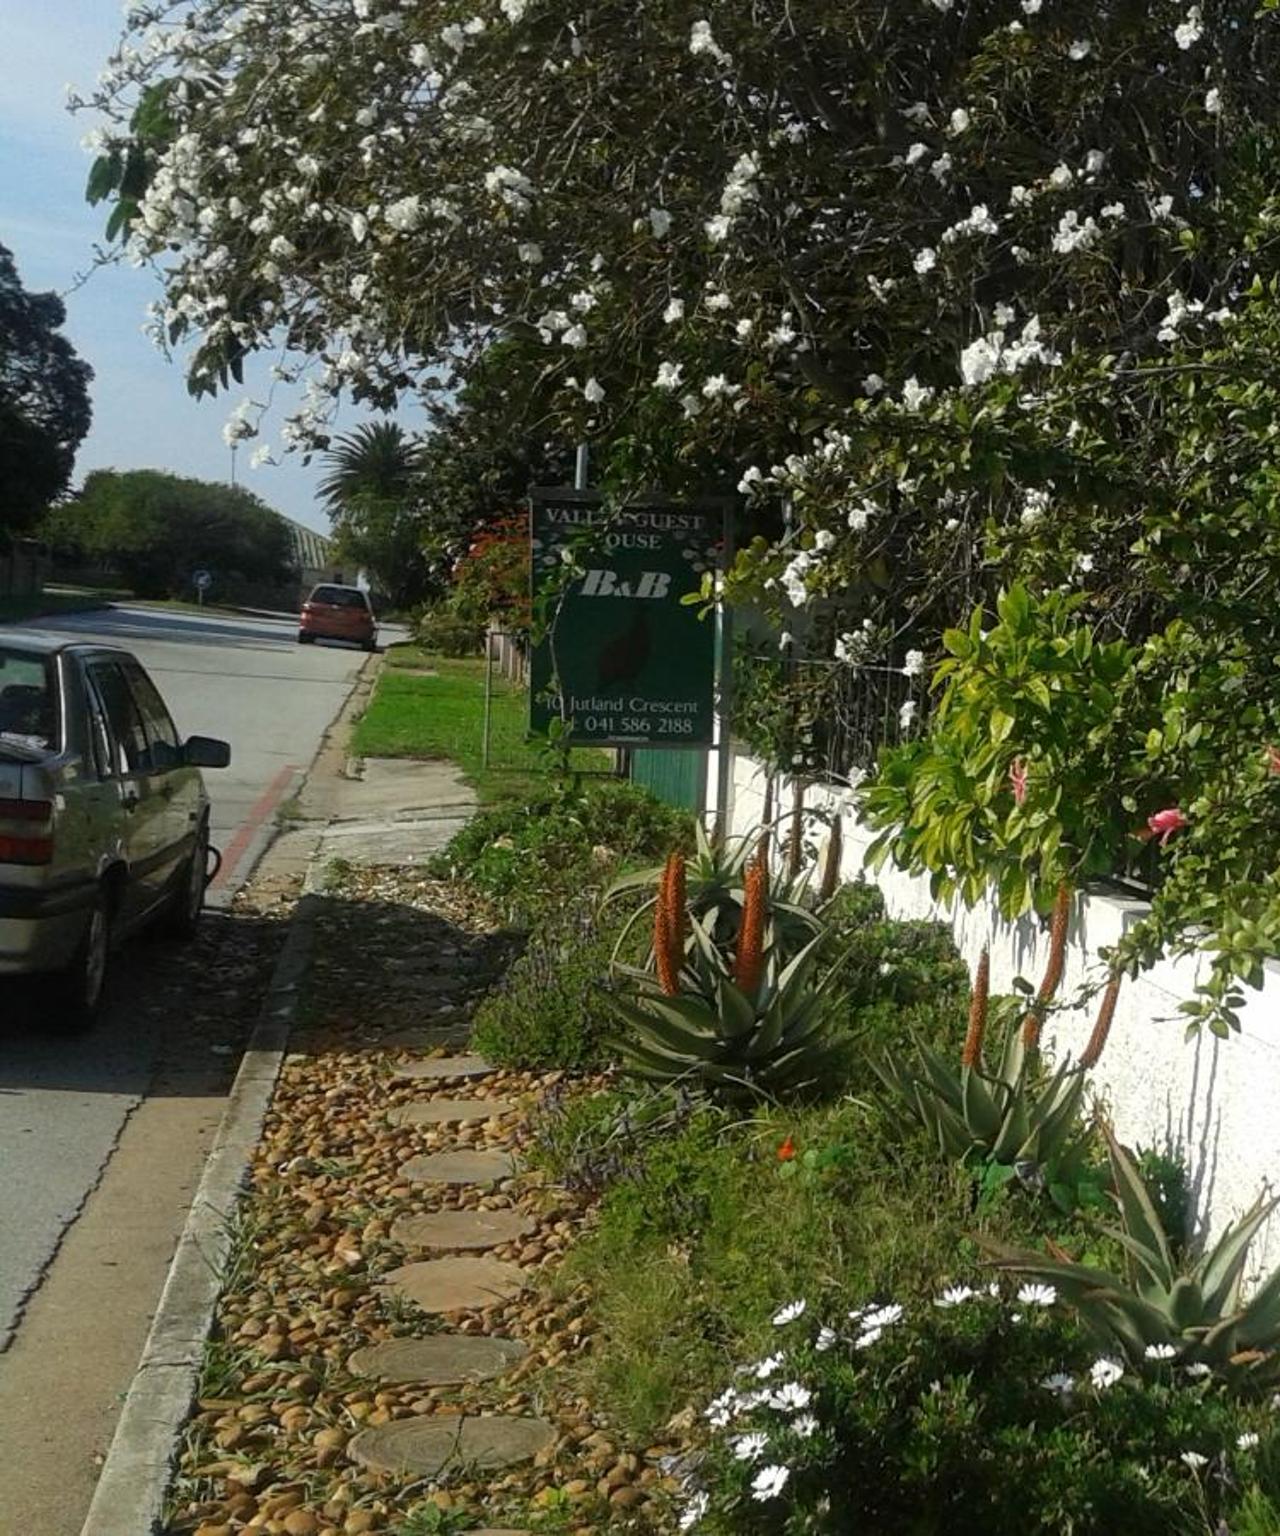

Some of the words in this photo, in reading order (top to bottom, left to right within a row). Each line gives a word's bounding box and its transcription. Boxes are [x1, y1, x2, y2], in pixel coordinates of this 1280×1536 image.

[635, 512, 704, 530] GUEST
[594, 532, 662, 550] OUSE
[579, 569, 672, 599] B&B
[569, 695, 624, 714] Jutland
[628, 697, 698, 713] Crescent
[584, 715, 614, 732] 041
[620, 717, 651, 733] 586
[657, 717, 694, 734] 2188
